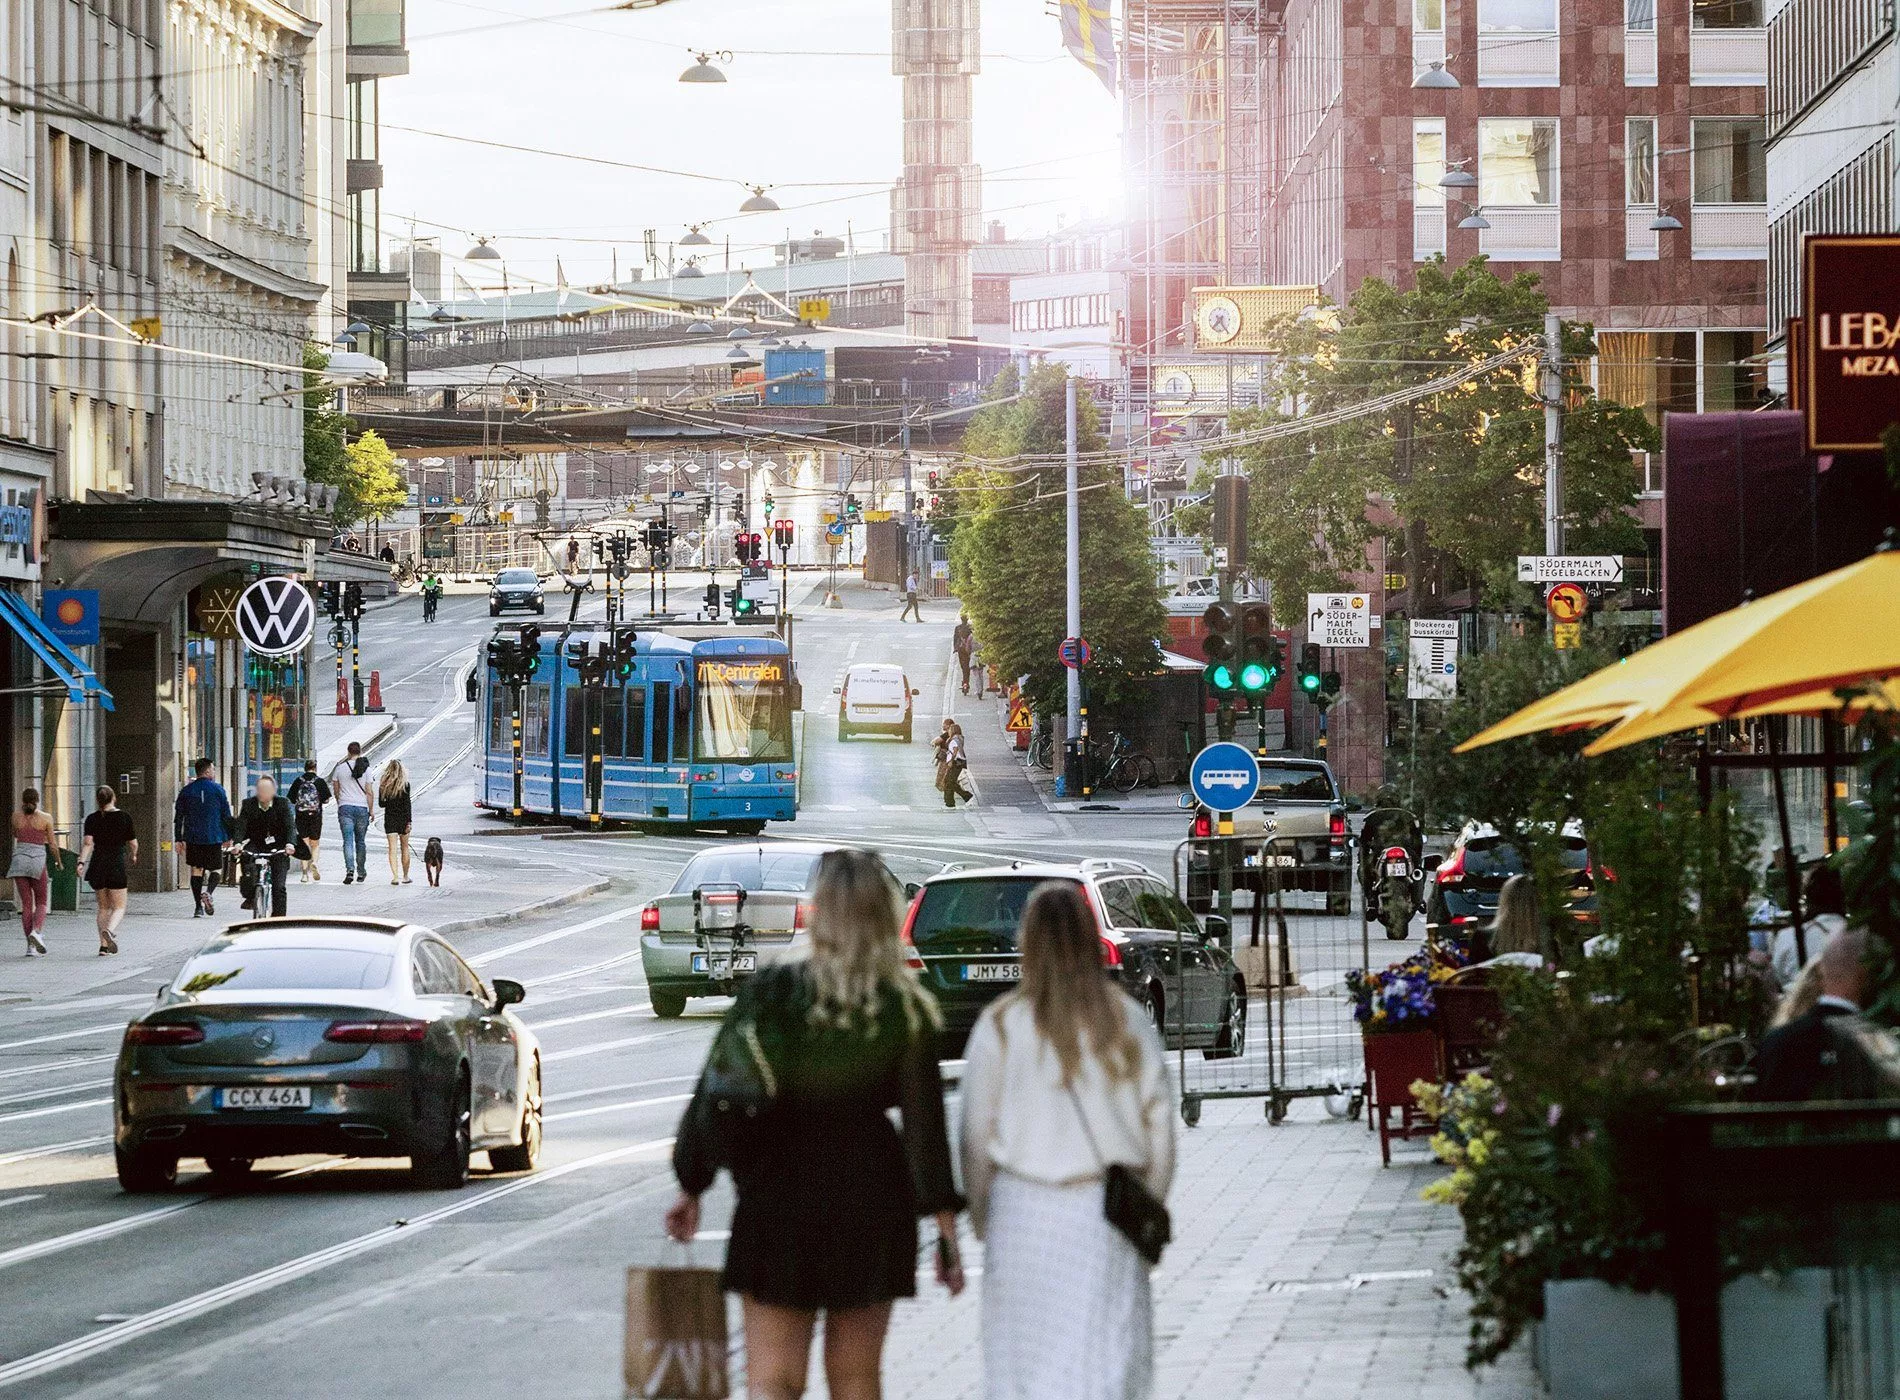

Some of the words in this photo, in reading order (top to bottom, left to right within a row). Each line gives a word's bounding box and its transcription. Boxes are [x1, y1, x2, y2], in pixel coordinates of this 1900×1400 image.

[1539, 558, 1602, 569] SÖDERMALM
[1539, 569, 1611, 577] TEGELBACKEN
[1326, 610, 1362, 620] SÖDER-
[1326, 620, 1353, 628] MALM
[1447, 622, 1455, 630] ej
[1326, 628, 1359, 636] TEGEL-
[1326, 636, 1364, 644] BACKEN
[744, 802, 751, 811] 3
[973, 966, 998, 978] JMY
[1002, 965, 1024, 978] 58
[229, 1089, 263, 1105] CCX
[269, 1089, 303, 1104] 46A
